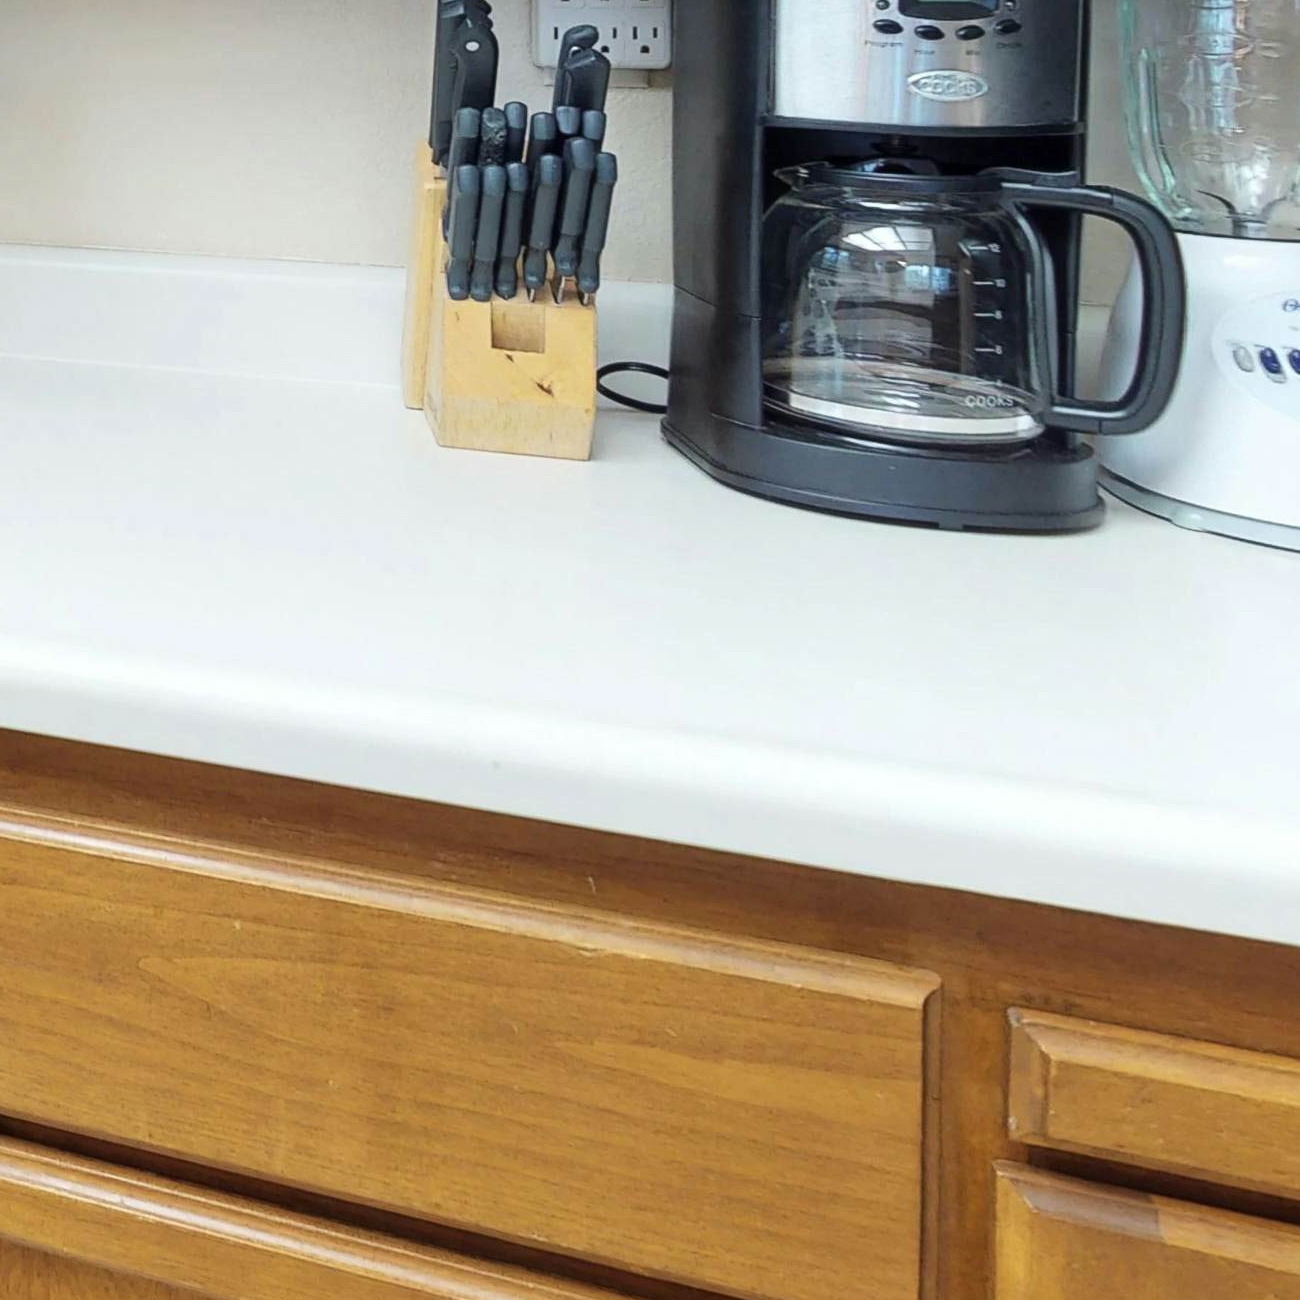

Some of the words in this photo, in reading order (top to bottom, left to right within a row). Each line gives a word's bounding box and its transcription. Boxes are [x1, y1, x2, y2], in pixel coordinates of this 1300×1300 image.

[987, 243, 1001, 253] 12
[994, 278, 1006, 288] 10
[964, 395, 1014, 408] COOKS
